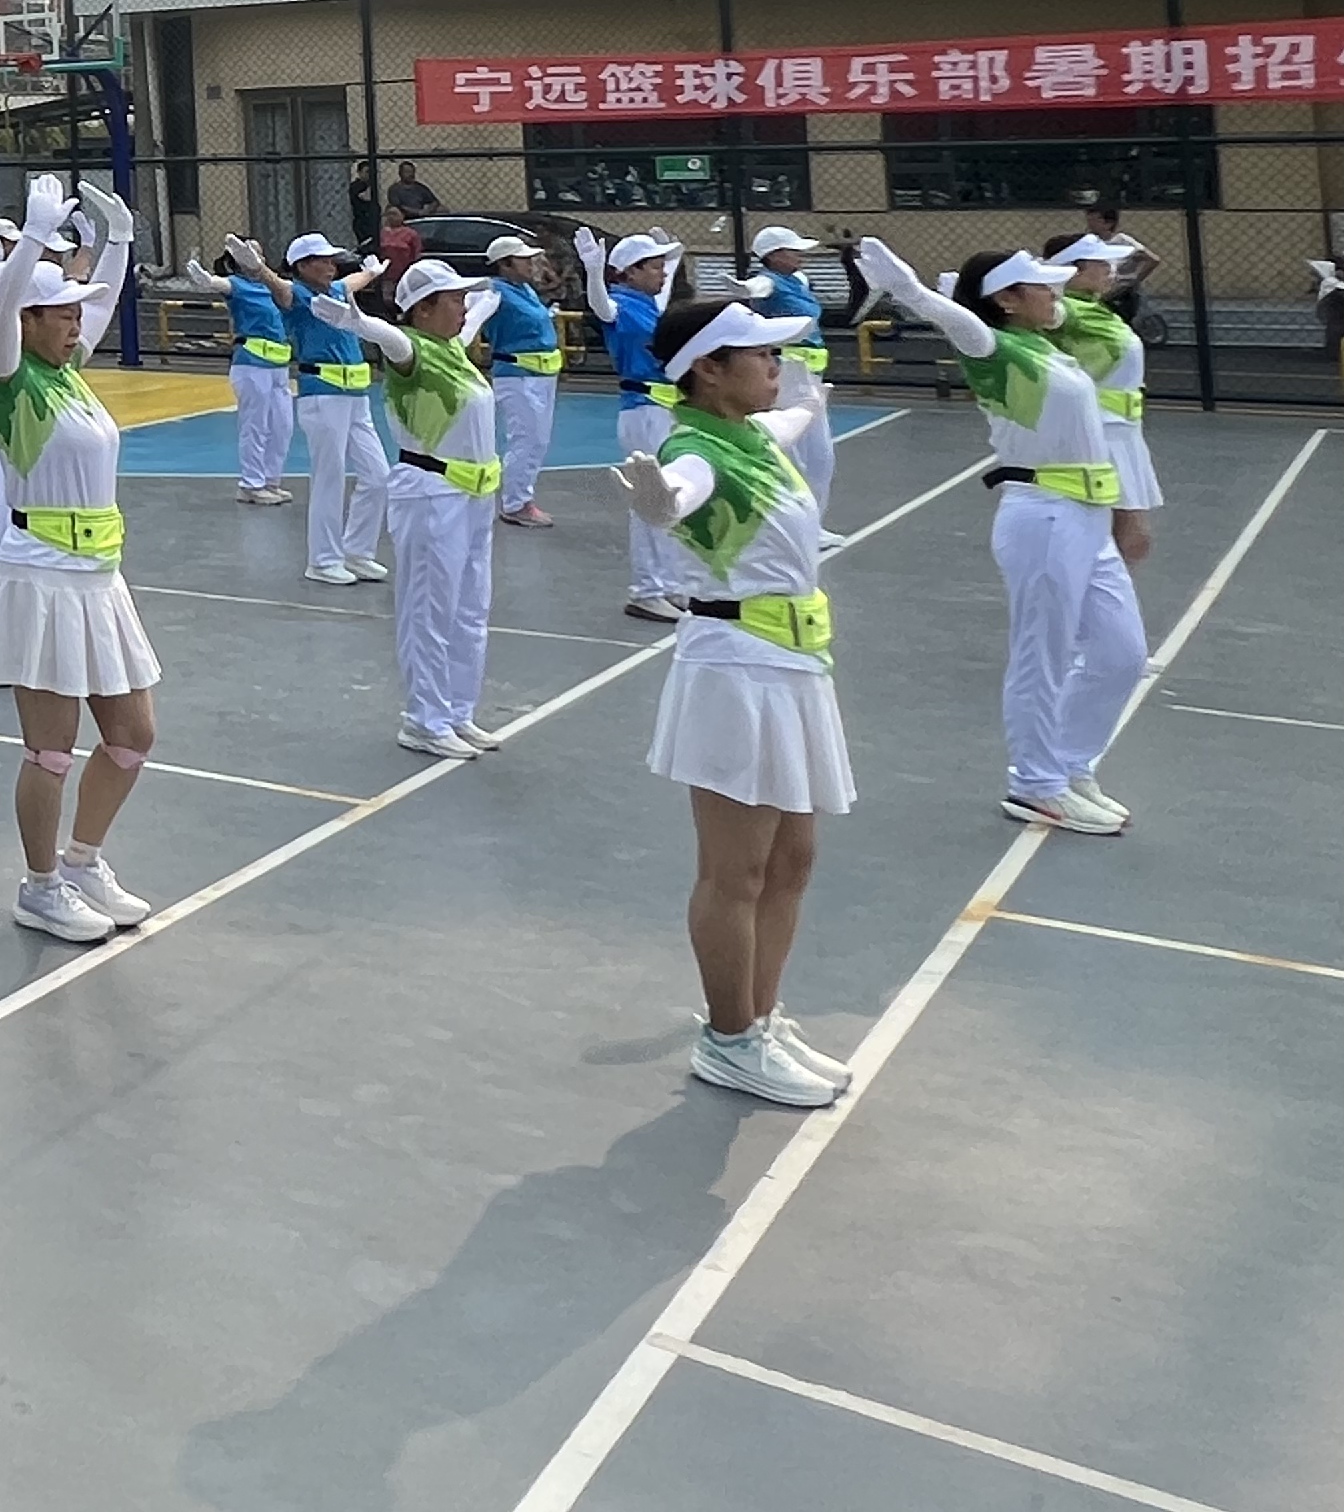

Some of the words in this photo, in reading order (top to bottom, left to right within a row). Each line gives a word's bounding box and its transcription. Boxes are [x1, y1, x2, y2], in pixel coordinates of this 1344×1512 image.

[453, 34, 1344, 112] 宁远篮球俱乐部暑期招
